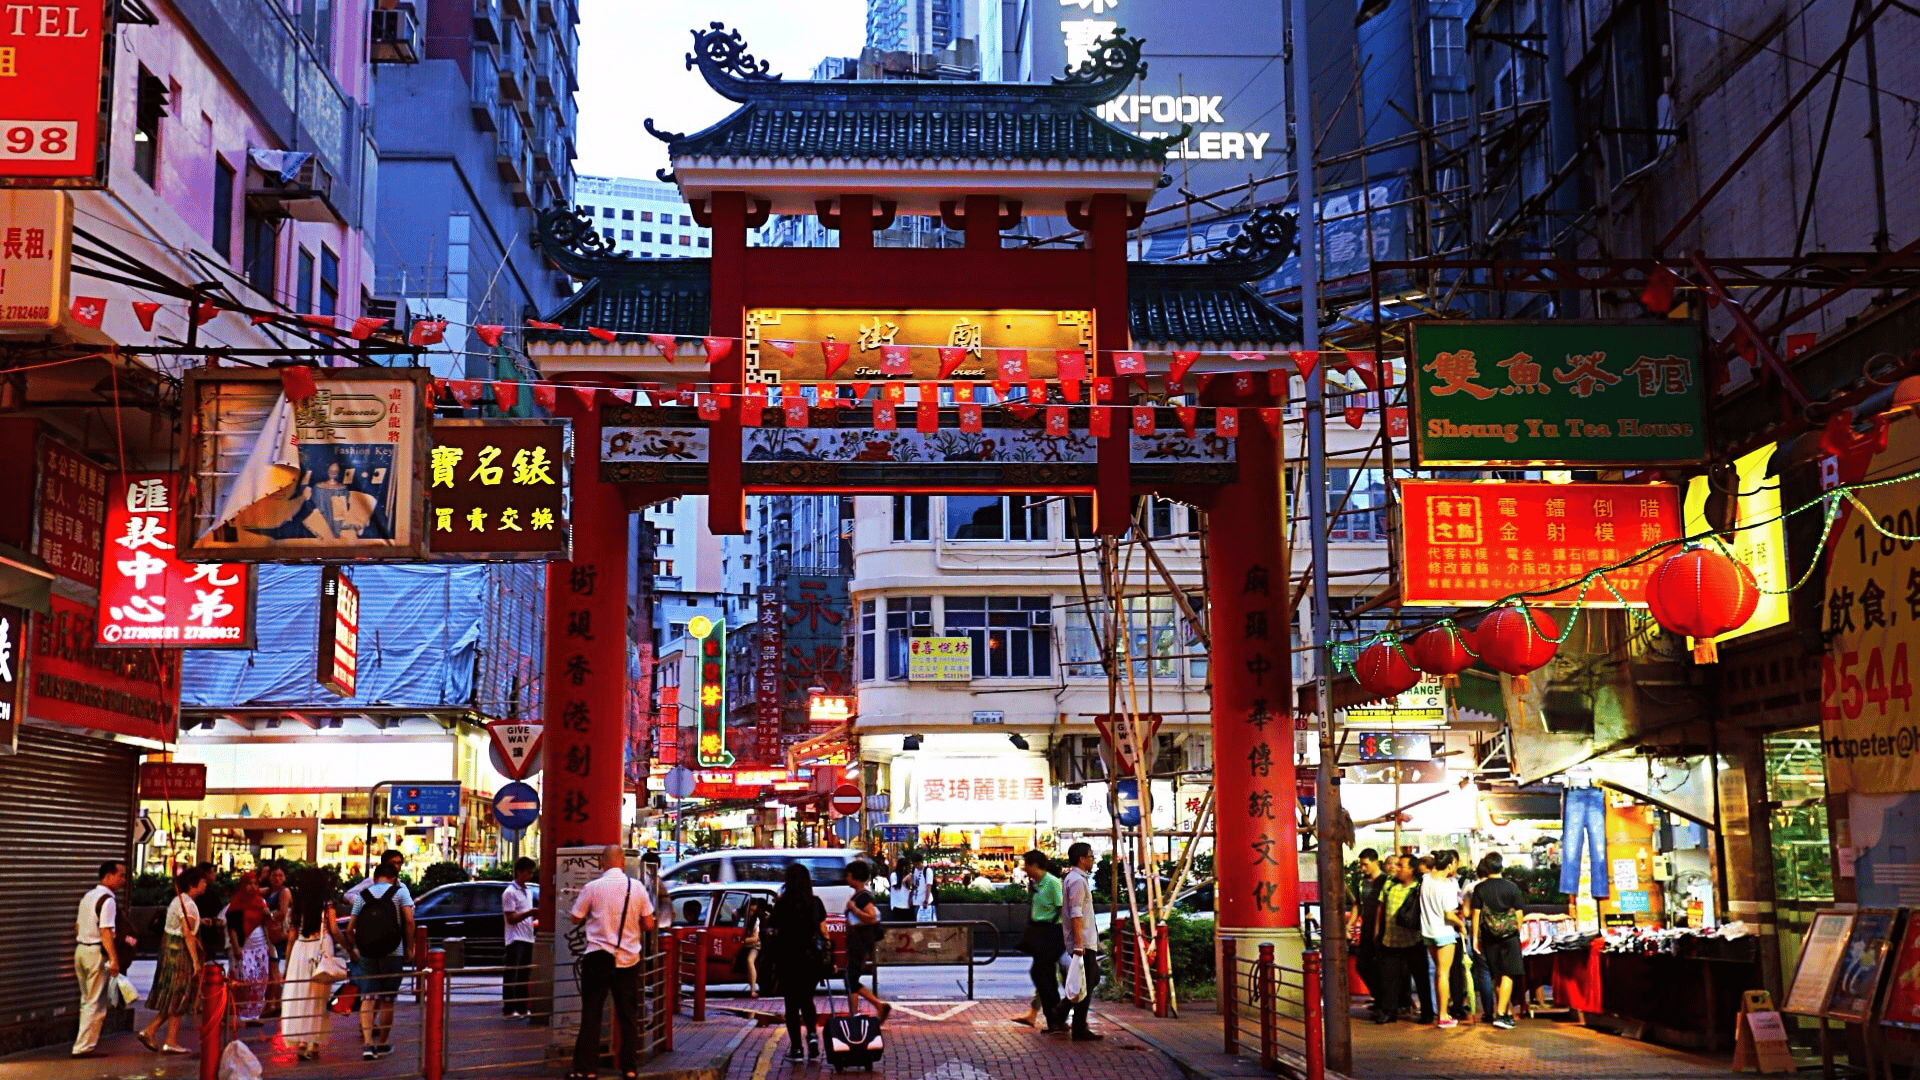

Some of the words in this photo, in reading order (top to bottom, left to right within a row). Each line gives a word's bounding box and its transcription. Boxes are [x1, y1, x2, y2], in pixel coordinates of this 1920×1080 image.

[6, 4, 88, 37] TEL
[1423, 350, 1693, 400] 雙魚茶館
[1428, 418, 1518, 443] Sheung
[1524, 418, 1560, 438] Yu
[1565, 418, 1611, 438] Tea
[1618, 418, 1694, 437] House
[431, 445, 555, 488] 寶名錶
[507, 727, 530, 735] GIVE
[508, 735, 529, 744] WAY
